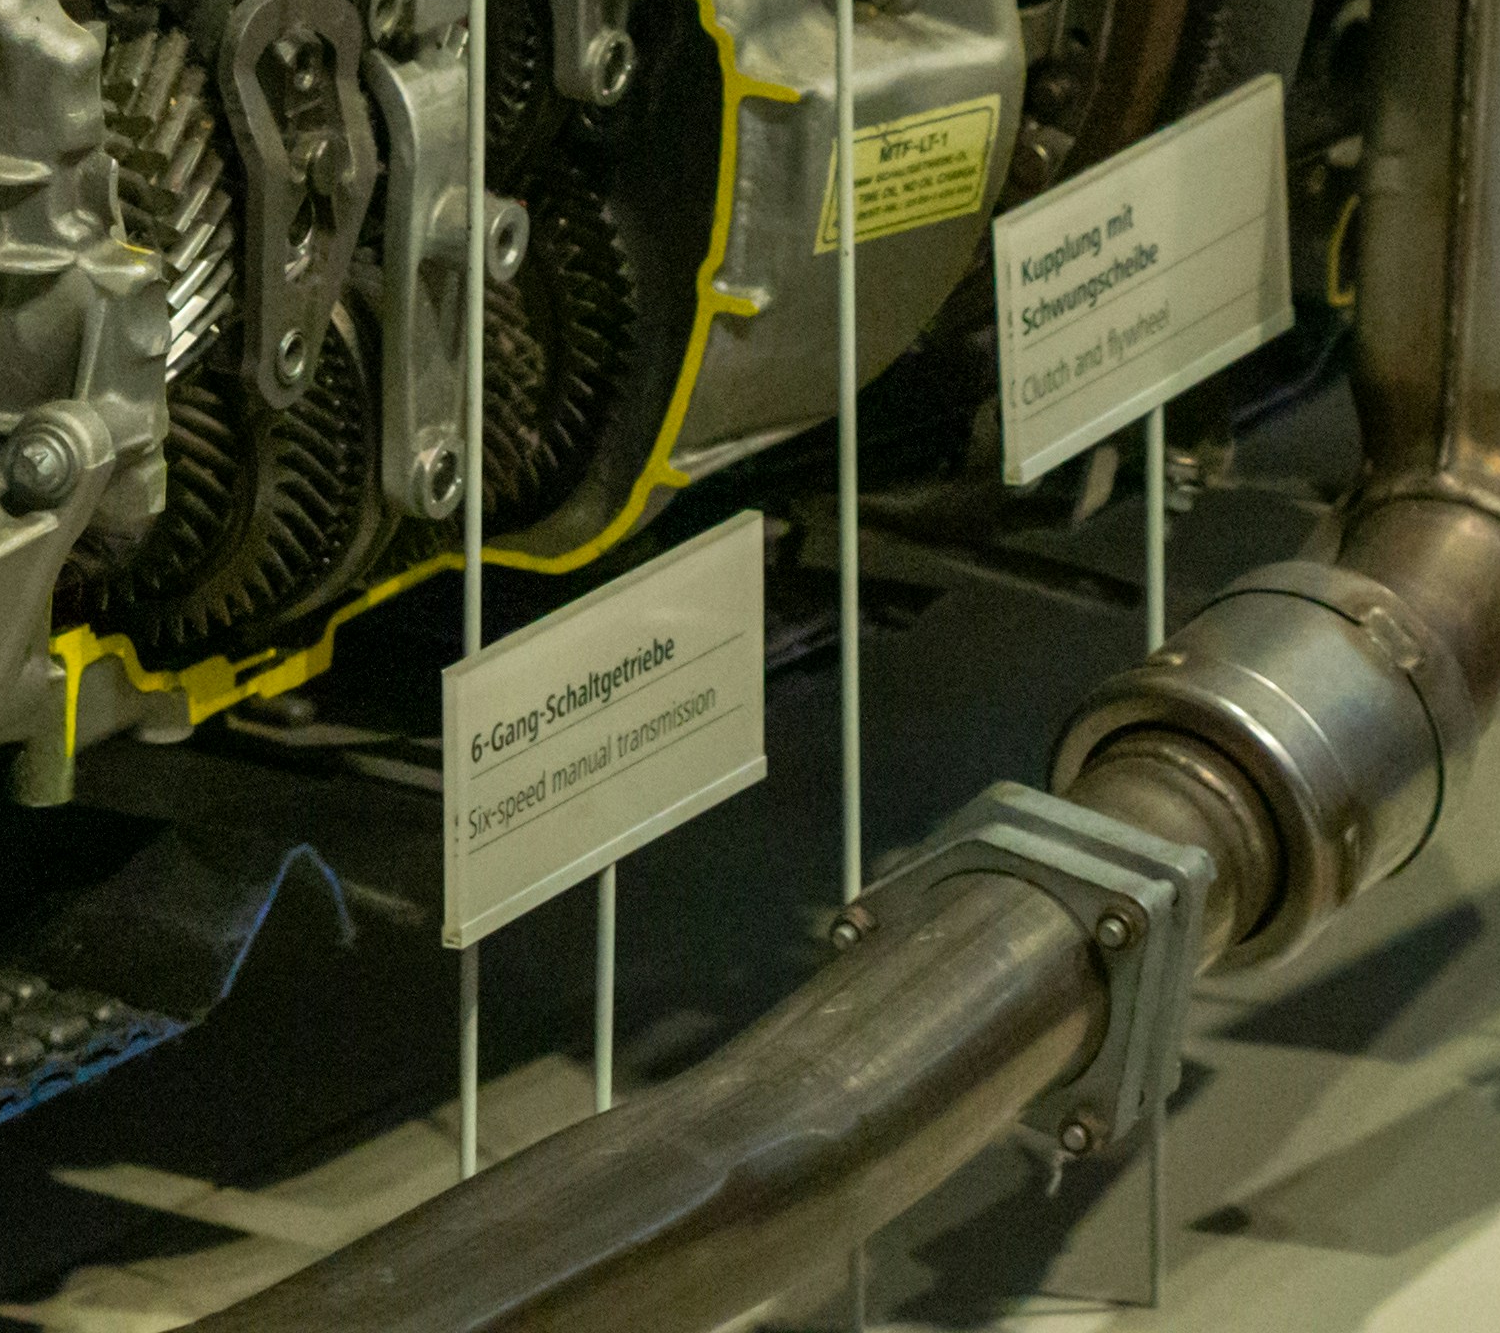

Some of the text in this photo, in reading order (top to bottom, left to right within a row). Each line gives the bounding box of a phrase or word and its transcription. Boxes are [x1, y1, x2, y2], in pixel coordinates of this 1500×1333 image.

[1020, 202, 1134, 287] Kupplung mit
[1021, 241, 1159, 336] Schwungscheibe
[1021, 297, 1171, 408] Clutch and flywheel
[470, 637, 675, 762] 6-Gang-Schaltgetriebe
[467, 684, 717, 840] Six-speed manual transmission
